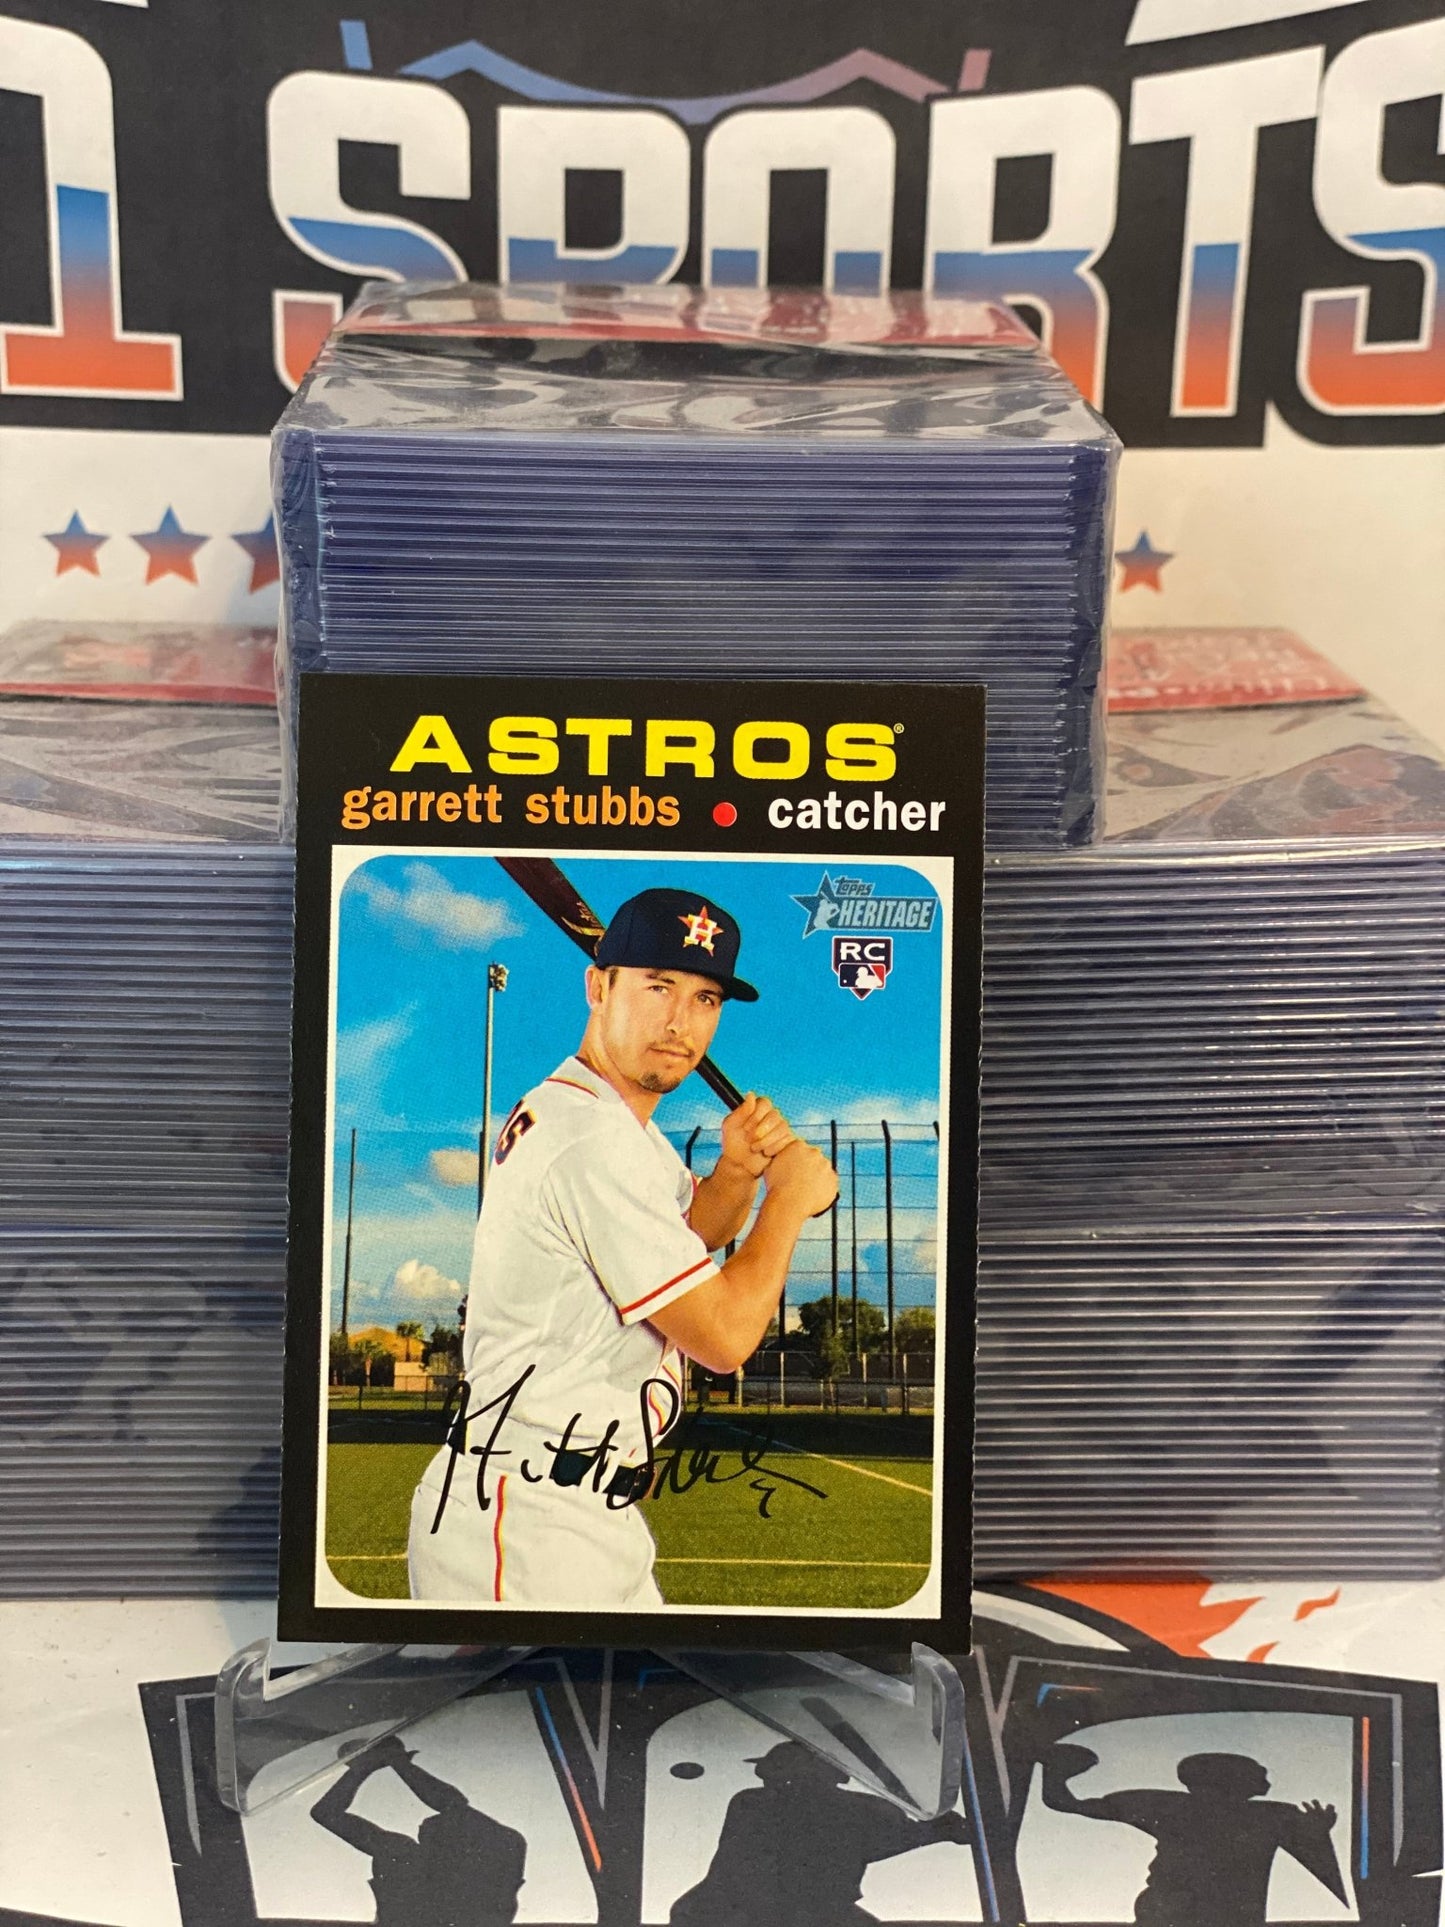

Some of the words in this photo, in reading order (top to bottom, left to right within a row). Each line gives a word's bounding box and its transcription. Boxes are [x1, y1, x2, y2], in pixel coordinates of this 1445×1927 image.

[340, 784, 504, 830] garrett
[525, 785, 681, 828] stubbs
[768, 790, 947, 833] catcher
[838, 898, 933, 929] HERITAGE
[840, 942, 886, 961] RC
